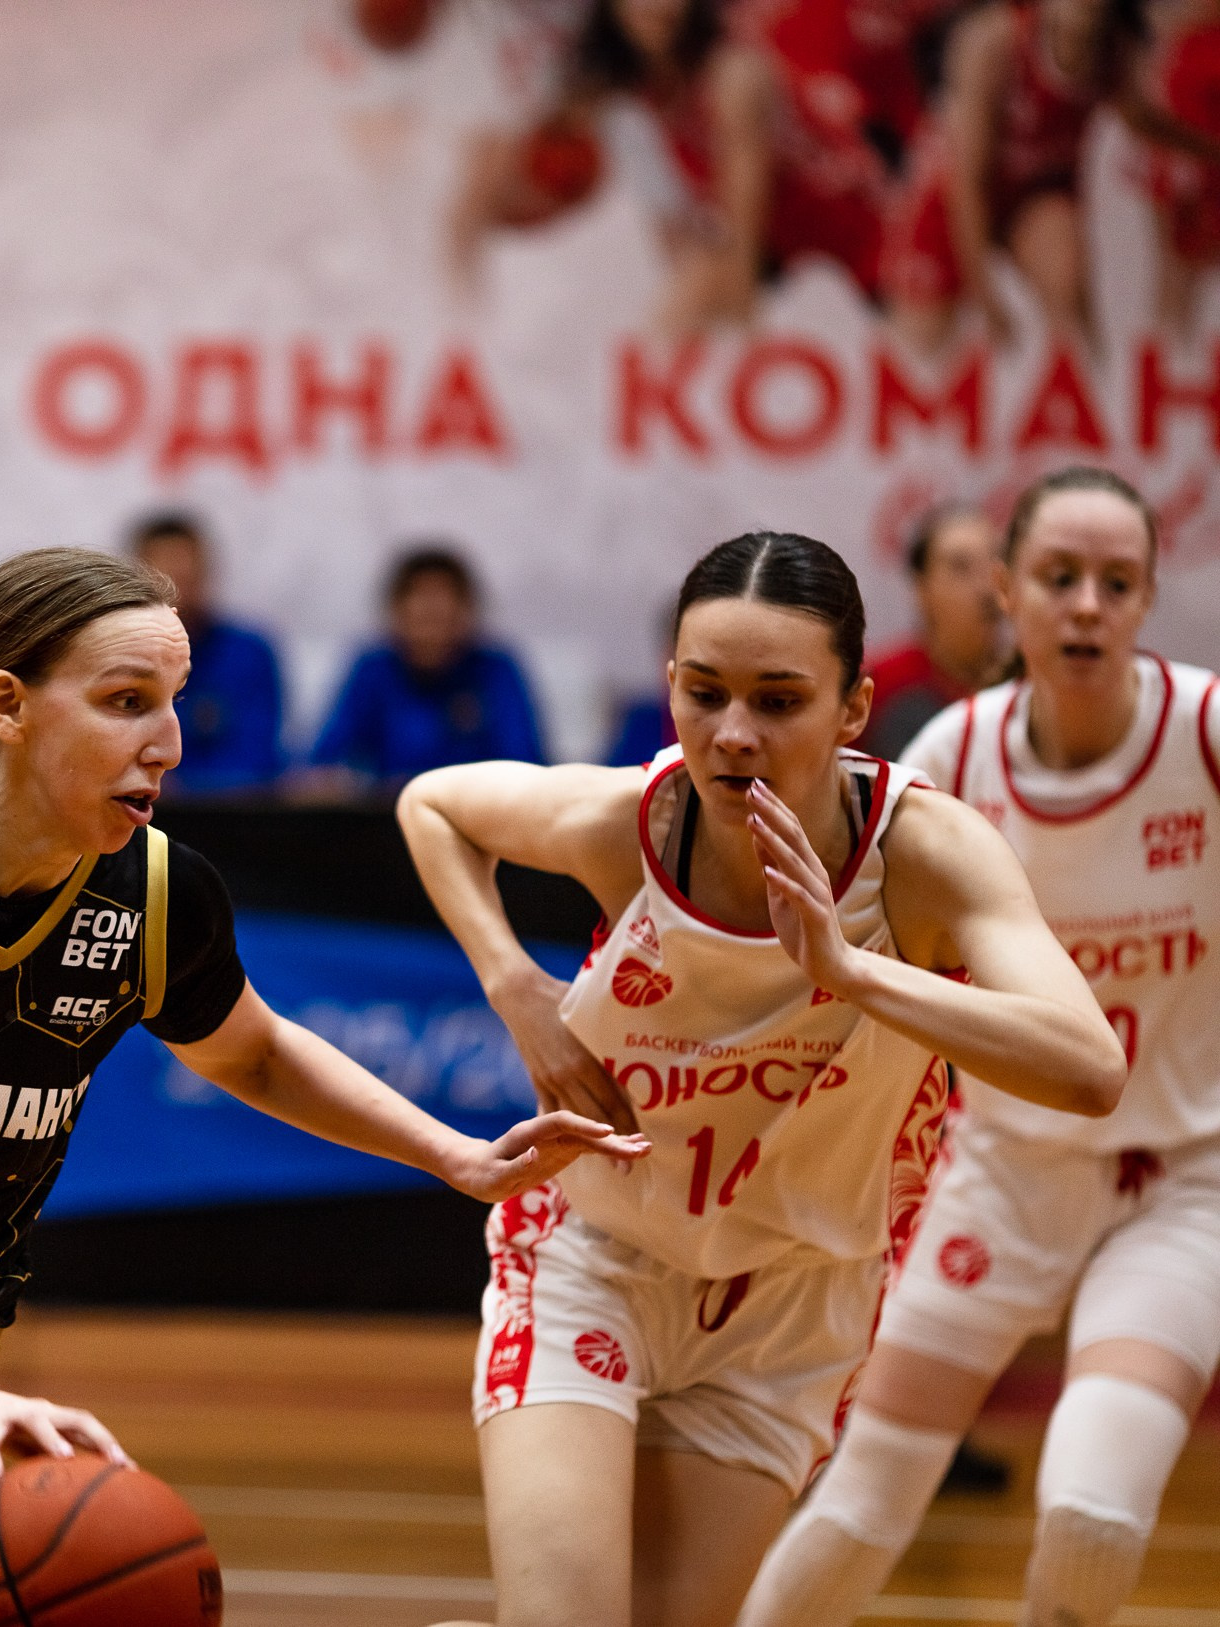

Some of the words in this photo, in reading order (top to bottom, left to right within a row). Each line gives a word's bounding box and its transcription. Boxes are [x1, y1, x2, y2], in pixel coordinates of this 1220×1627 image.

[30, 336, 513, 482] ОДНА
[613, 336, 1220, 464] КОМАН
[69, 908, 143, 940] FON
[60, 938, 132, 971] BET
